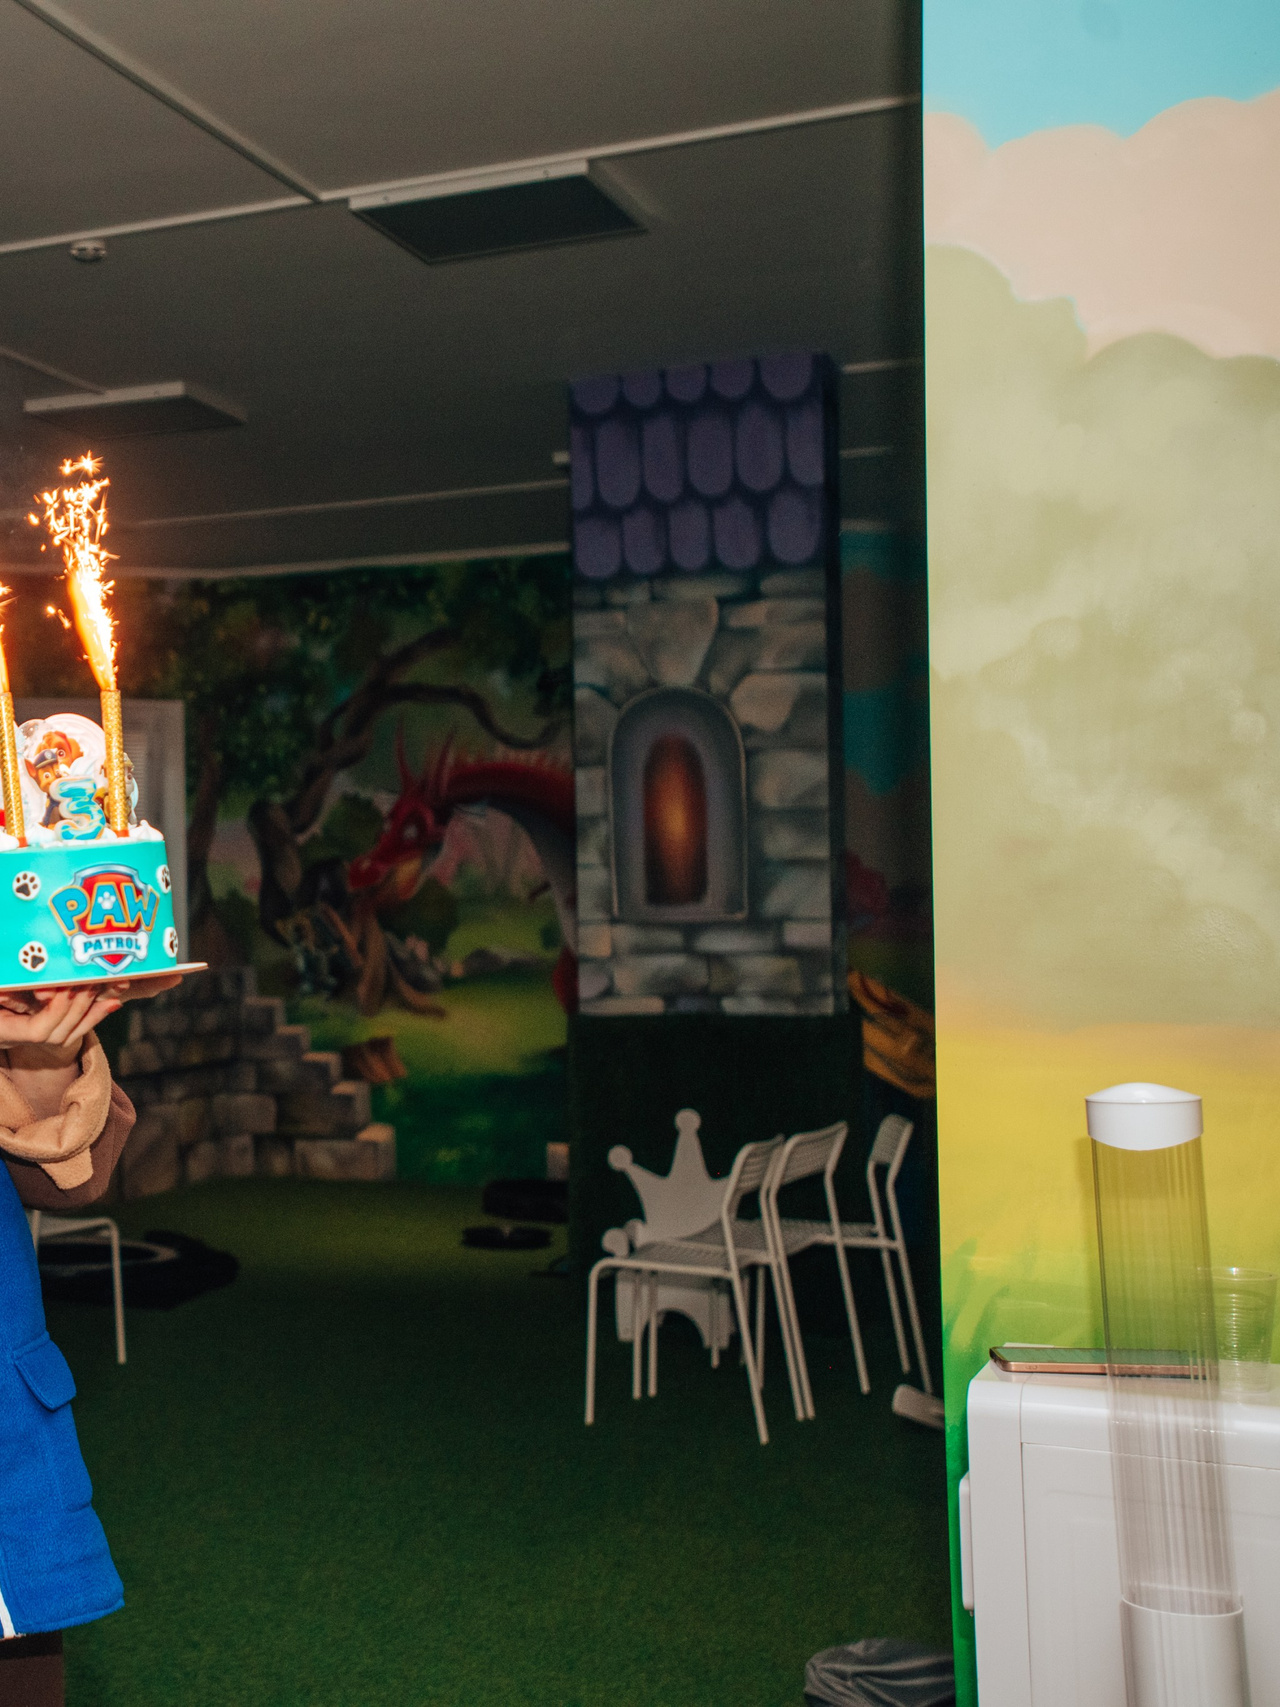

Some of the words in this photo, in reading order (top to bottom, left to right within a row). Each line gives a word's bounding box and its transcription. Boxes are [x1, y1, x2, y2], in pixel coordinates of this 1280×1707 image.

[51, 777, 106, 840] 3
[49, 882, 159, 936] PAW
[83, 937, 142, 953] PATROL
